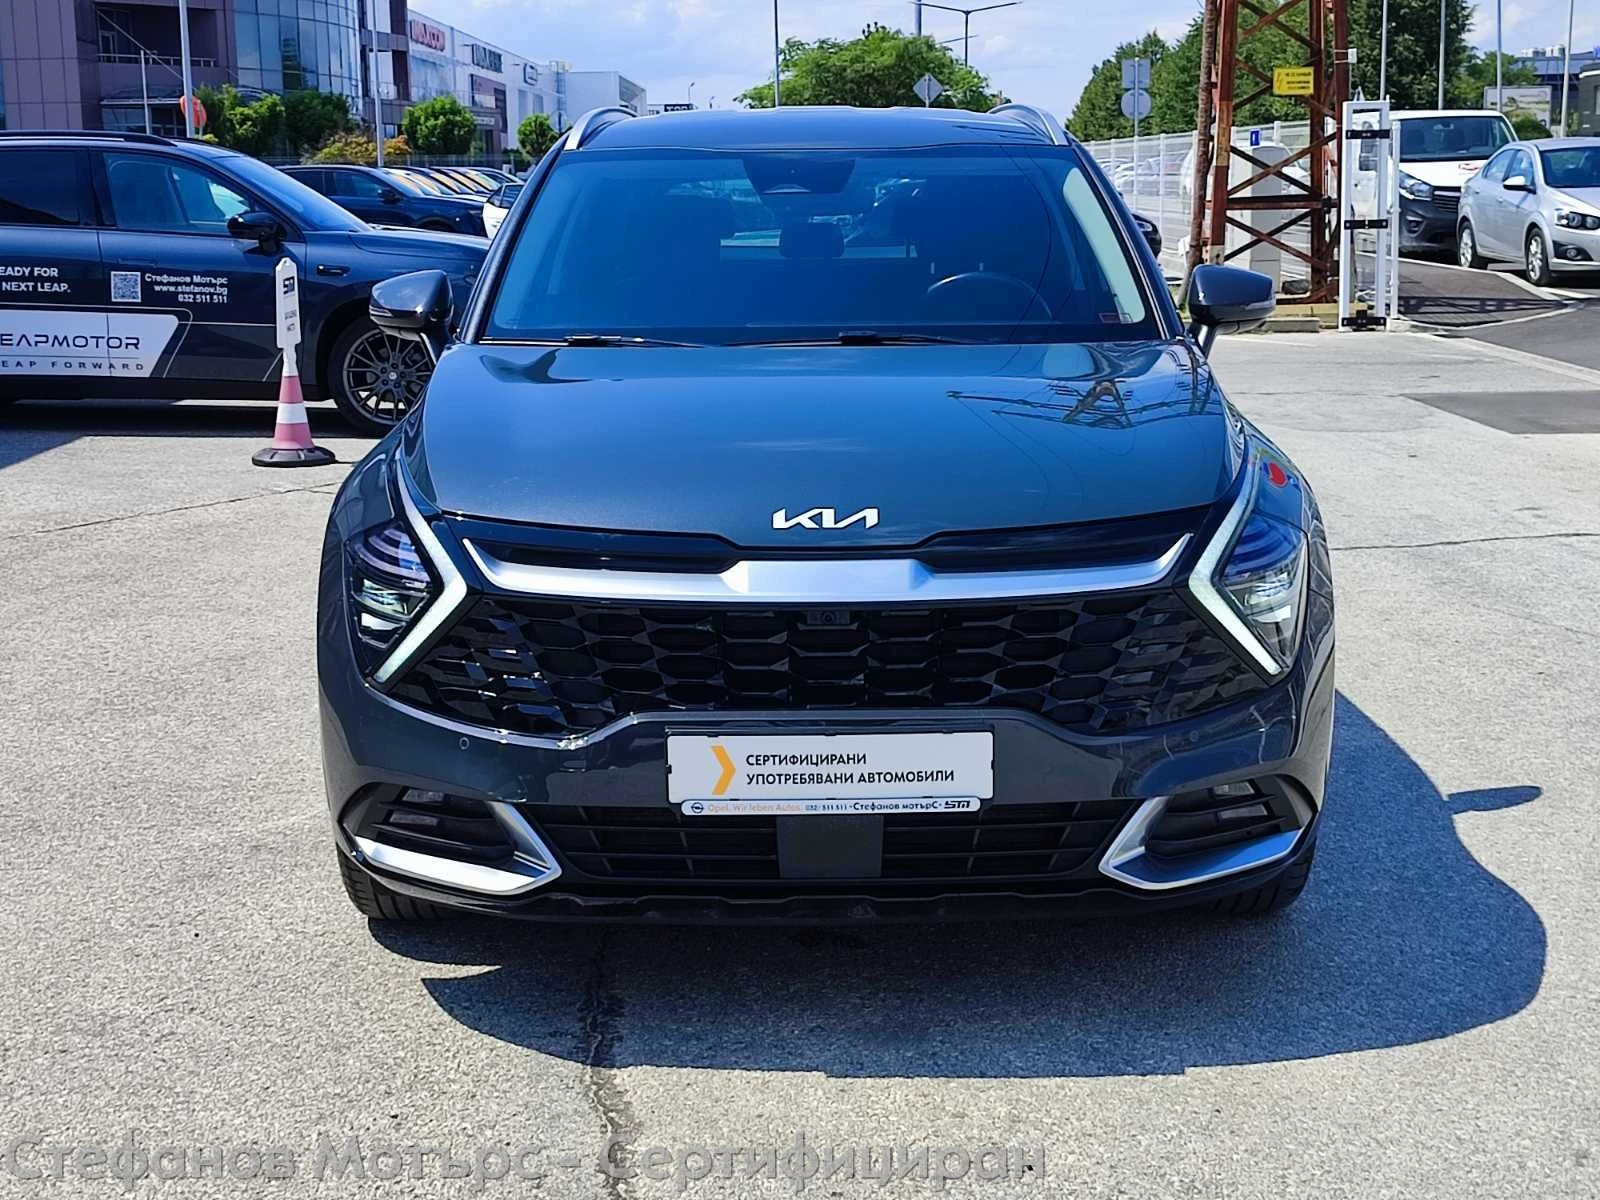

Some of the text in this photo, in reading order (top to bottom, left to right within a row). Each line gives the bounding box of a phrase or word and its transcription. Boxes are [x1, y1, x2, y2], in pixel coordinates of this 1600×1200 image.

[34, 267, 58, 277] FOR
[145, 273, 228, 285] Стефанов Мотърс
[2, 281, 71, 293] NEXT LEAP.
[154, 285, 228, 295] www.stefanov.bg
[178, 294, 227, 303] 032 511 511
[51, 361, 144, 371] FORWARD
[772, 508, 879, 529] KIA
[745, 753, 867, 767] СЕРТИФИЦИРАНИ
[746, 770, 954, 785] УПОТРЕБЯВАНИ АВТОМОБИЛИ
